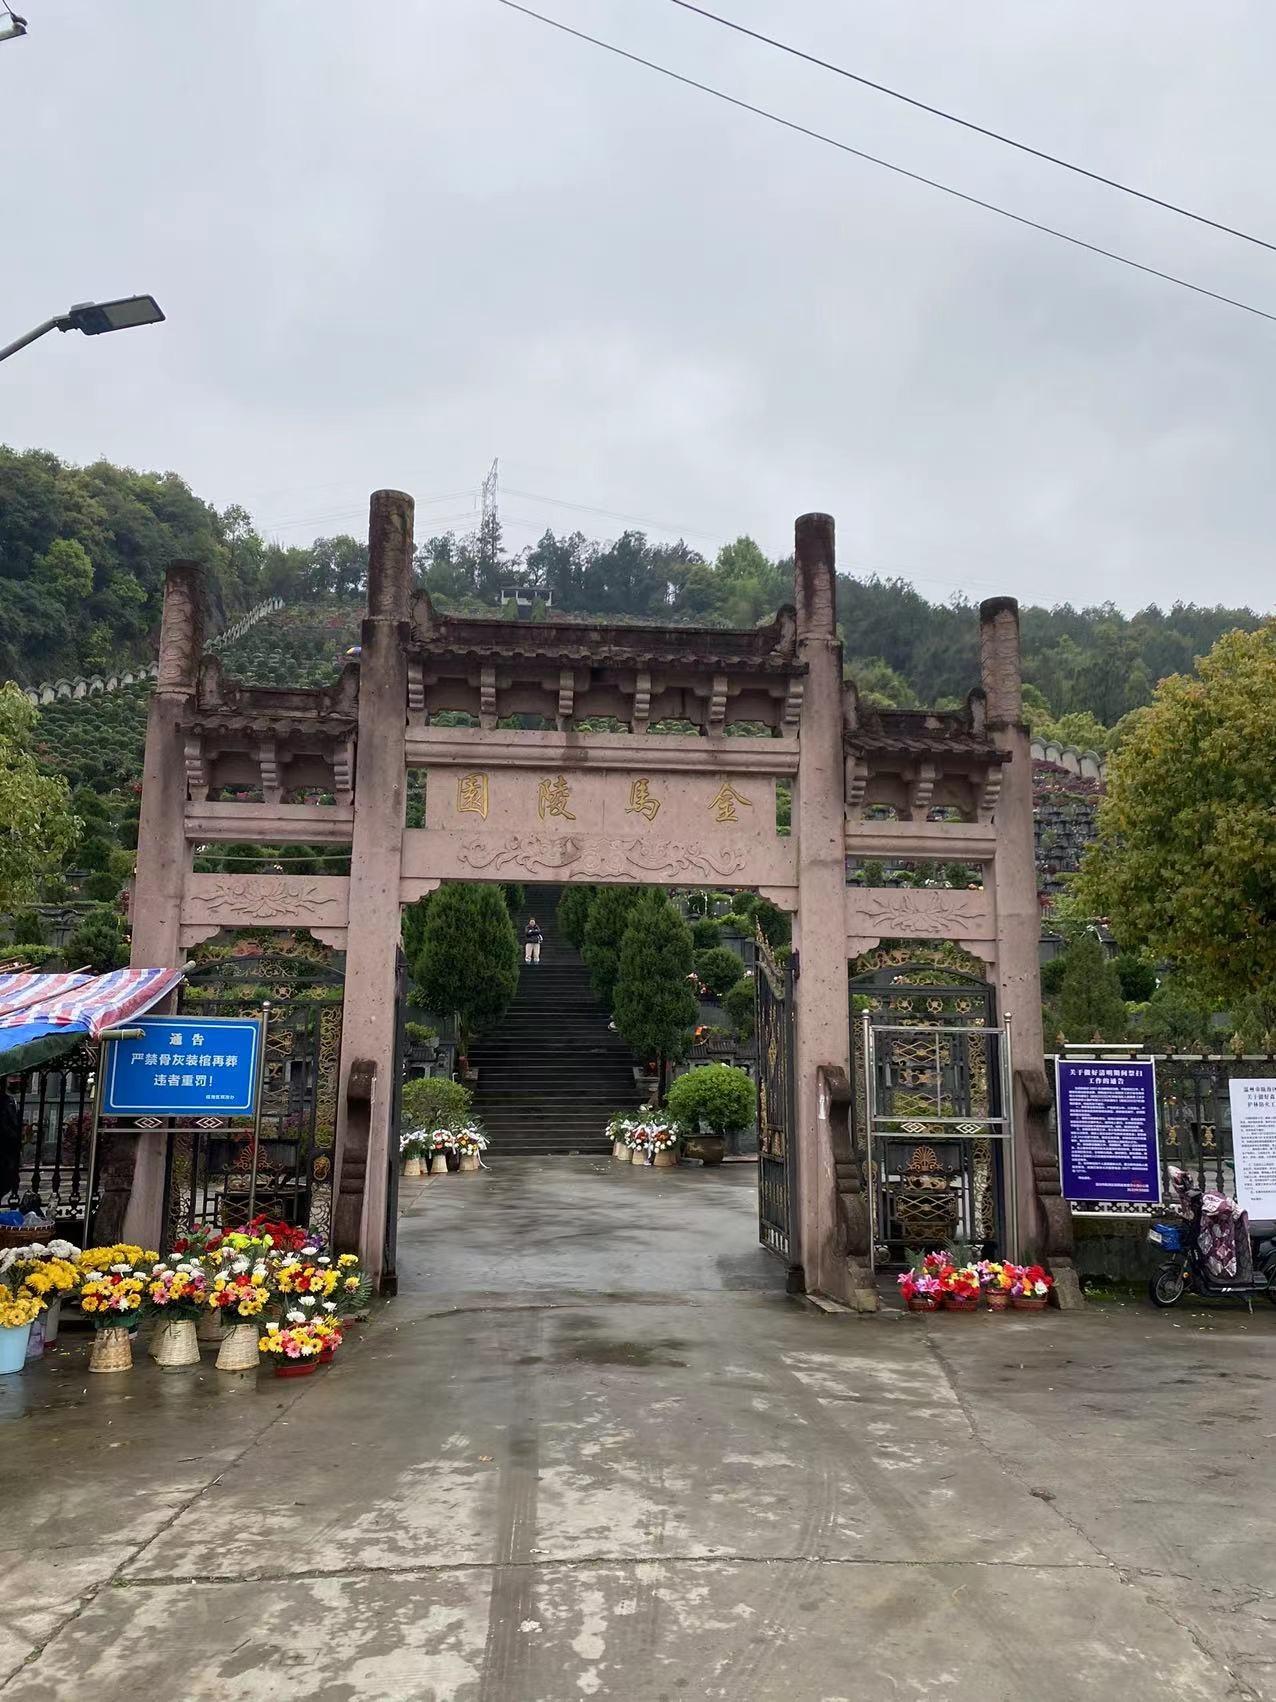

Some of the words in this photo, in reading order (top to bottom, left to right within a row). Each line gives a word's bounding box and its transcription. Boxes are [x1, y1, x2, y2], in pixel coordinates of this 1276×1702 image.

[457, 771, 752, 822] 金馬陵園
[169, 1032, 205, 1046] 通告
[130, 1053, 238, 1067] 严禁骨灰装棺再葬
